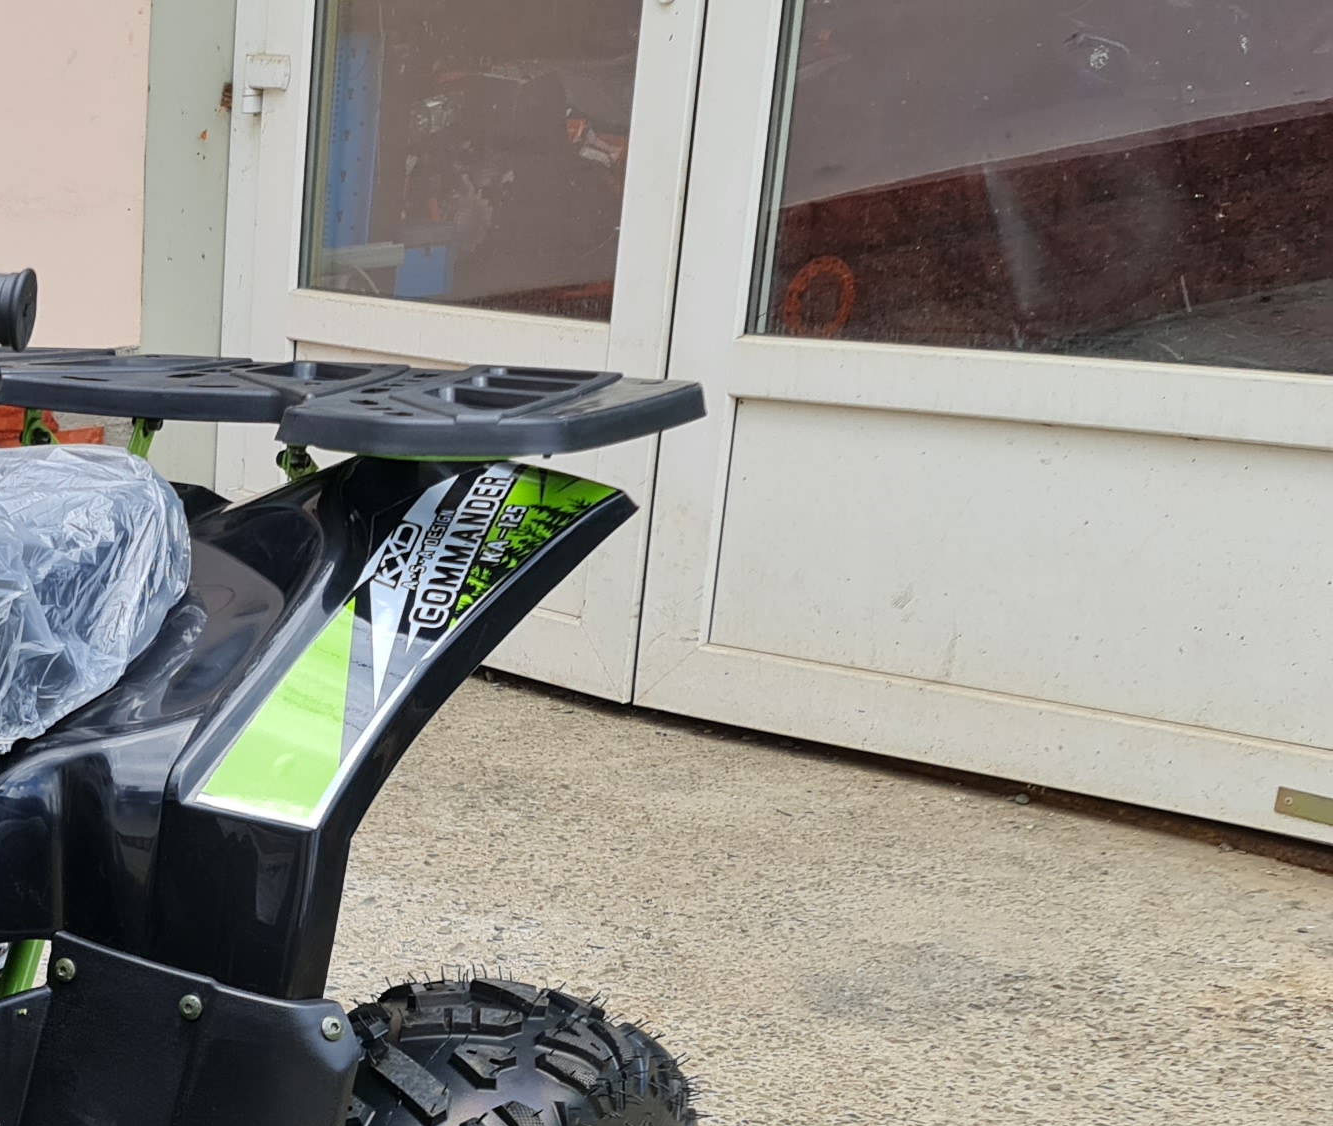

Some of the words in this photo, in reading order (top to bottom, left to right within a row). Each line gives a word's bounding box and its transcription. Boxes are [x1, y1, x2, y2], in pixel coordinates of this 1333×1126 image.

[373, 519, 423, 591] KXD
[409, 474, 515, 629] COMMANDER
[423, 509, 456, 547] DESIGN
